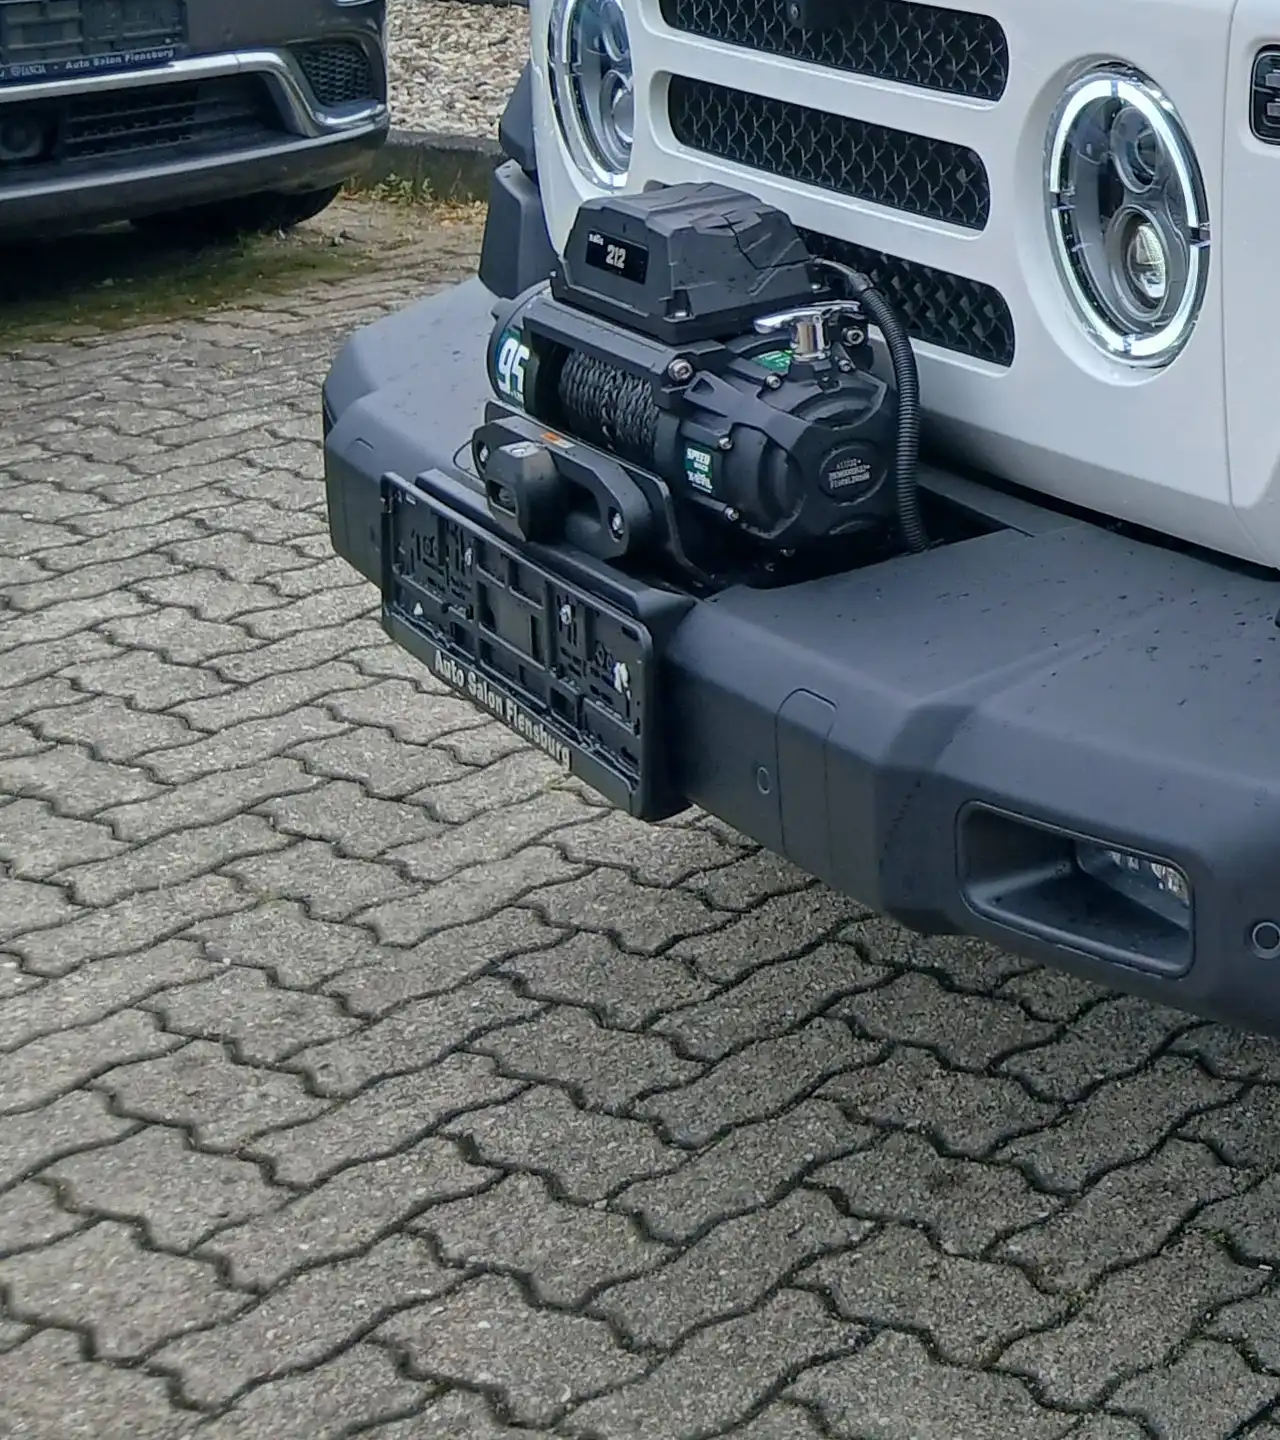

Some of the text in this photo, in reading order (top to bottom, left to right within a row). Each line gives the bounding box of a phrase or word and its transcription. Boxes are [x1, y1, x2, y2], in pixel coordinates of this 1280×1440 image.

[605, 244, 627, 269] 212
[434, 649, 570, 771] Auto Salon Flensburg
